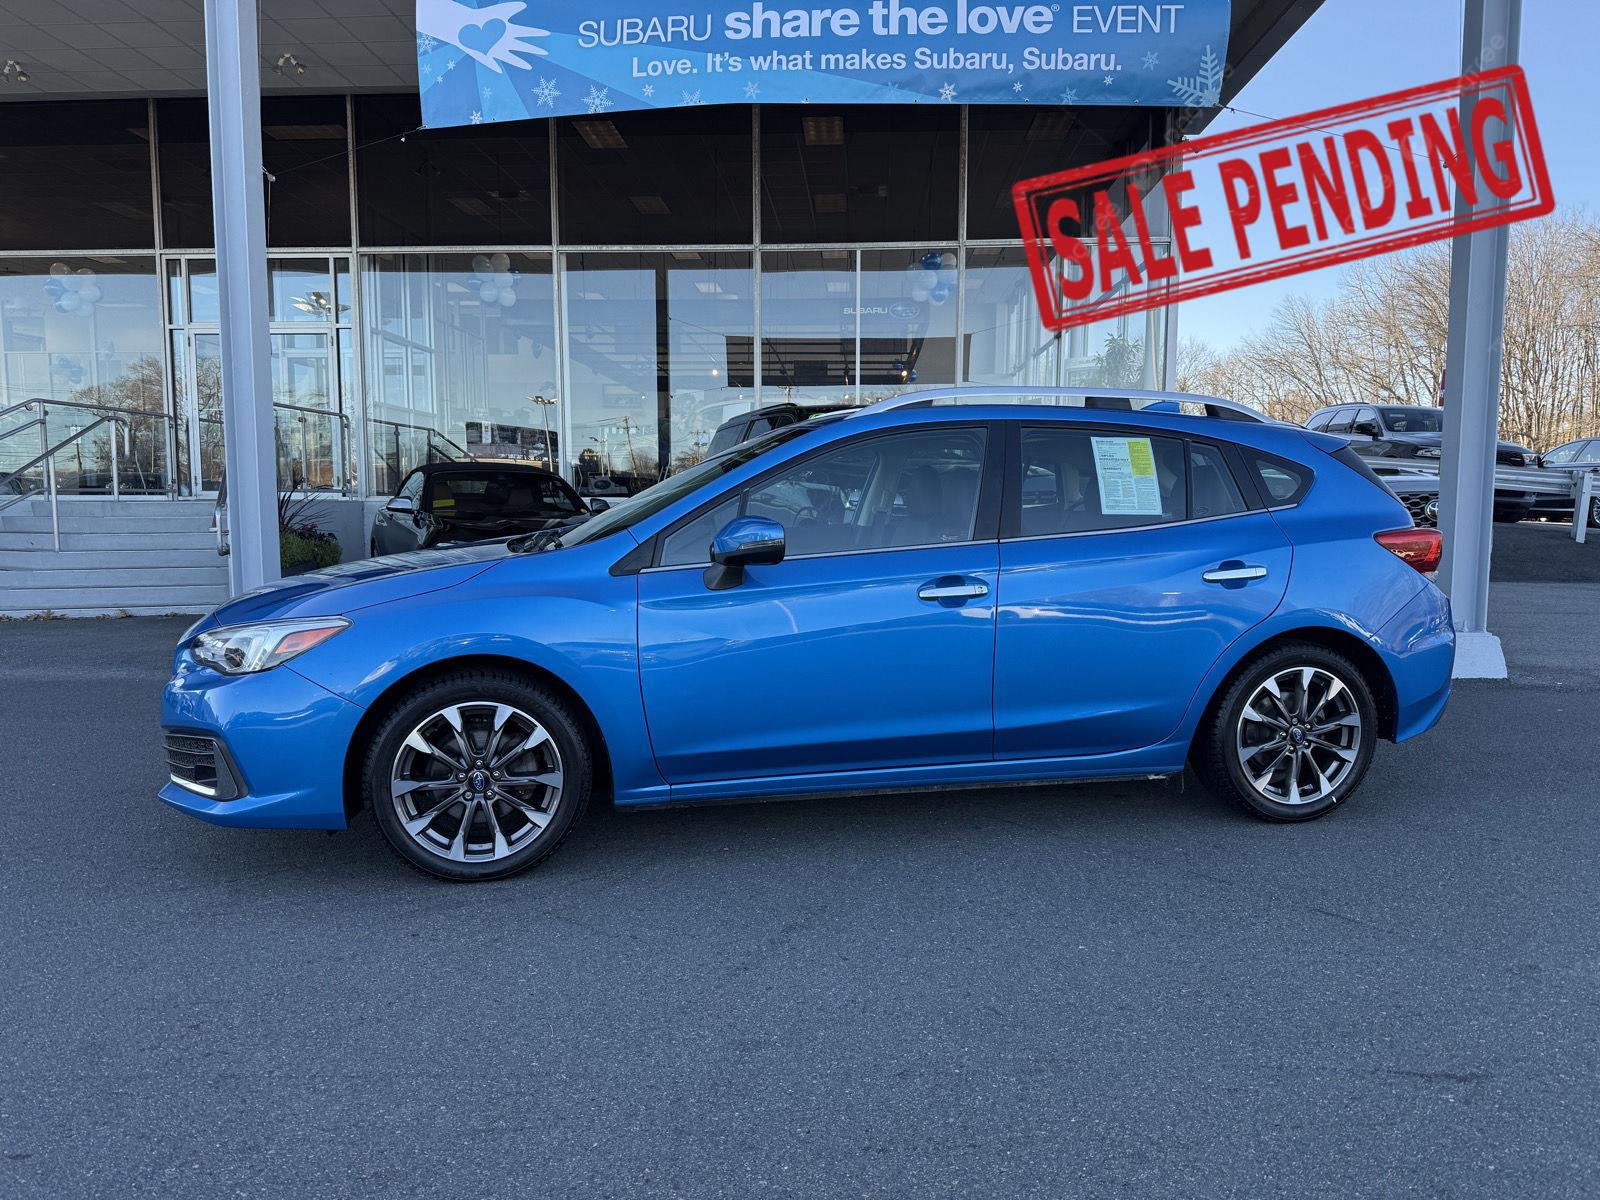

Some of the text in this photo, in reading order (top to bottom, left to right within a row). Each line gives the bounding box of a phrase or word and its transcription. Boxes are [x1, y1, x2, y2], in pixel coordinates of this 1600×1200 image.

[578, 14, 712, 48] SUBARU
[724, 2, 861, 40] share
[868, 0, 948, 36] the
[1073, 5, 1185, 33] EVENT
[631, 47, 1122, 77] Love. It's what makes Subaru, Subaru.
